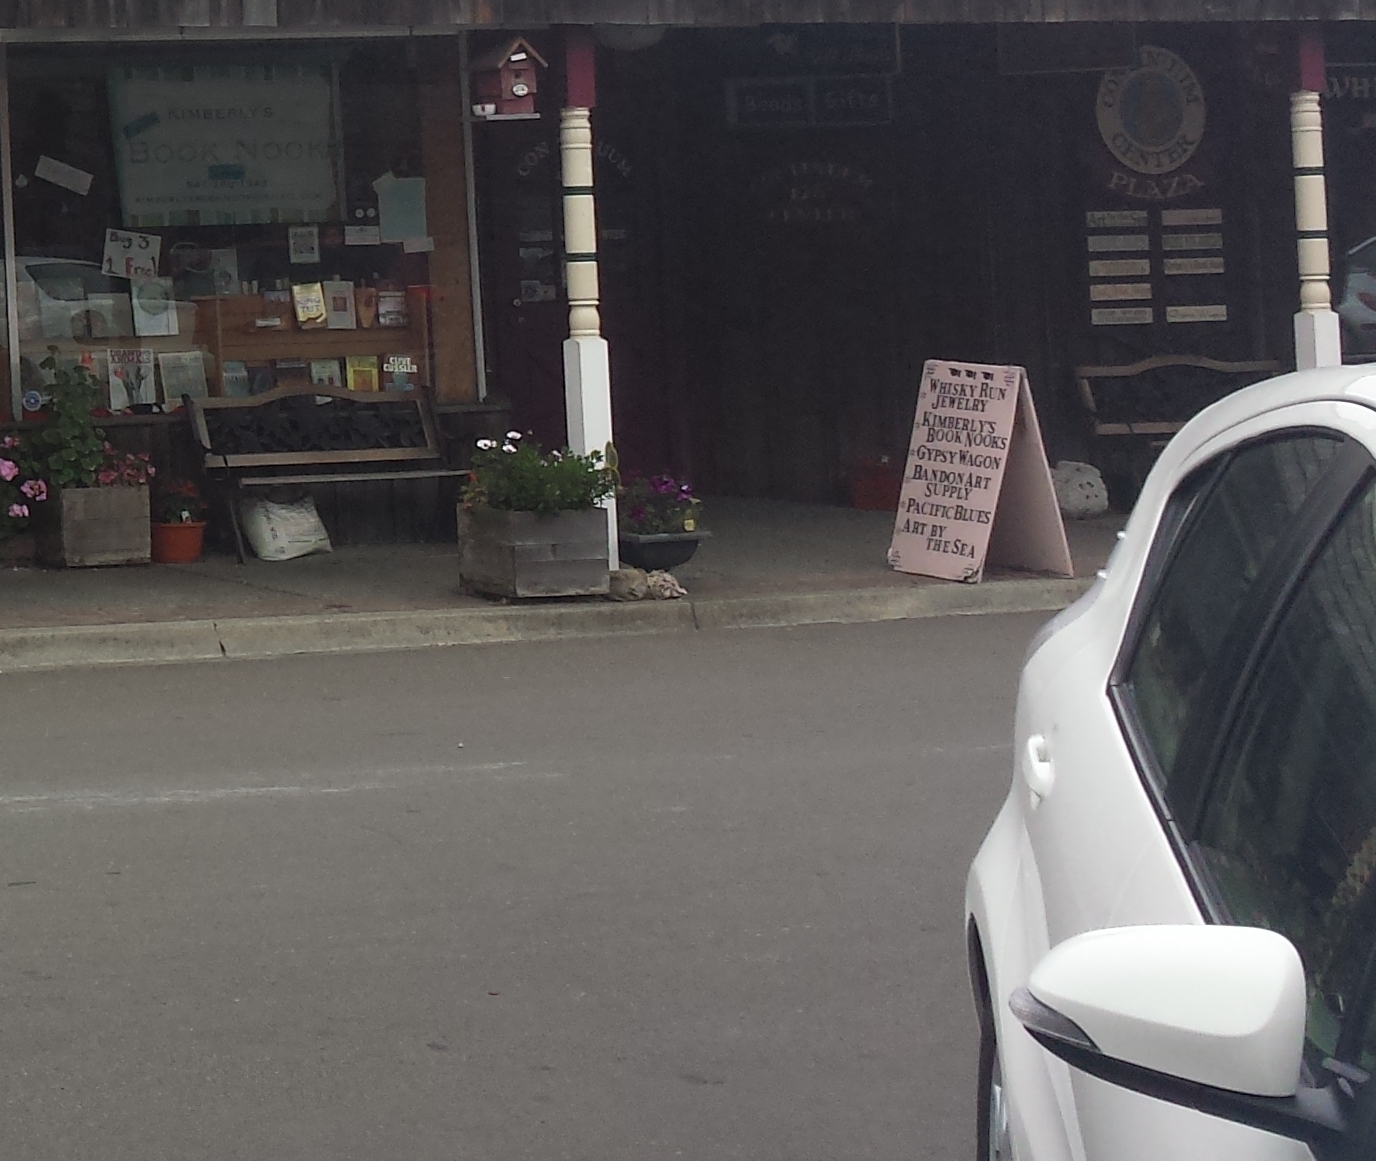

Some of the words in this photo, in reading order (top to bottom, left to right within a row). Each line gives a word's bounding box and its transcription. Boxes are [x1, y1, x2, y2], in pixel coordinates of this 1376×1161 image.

[129, 141, 217, 164] BOOK
[1112, 132, 1196, 167] CENTER
[1106, 170, 1205, 200] PLAZA
[138, 235, 150, 250] 3
[929, 378, 978, 398] WHISKY
[980, 382, 1008, 401] RUN
[931, 395, 988, 412] JEWELRY
[921, 411, 997, 434] KIMBERLY'S
[925, 427, 962, 444] BOOK
[964, 431, 1008, 450] NOOKS
[916, 445, 958, 464] GYPSY
[959, 450, 1002, 470] WAGON
[911, 464, 964, 485] BANDON
[965, 473, 992, 489] ART
[924, 482, 972, 500] SUPPLY
[905, 498, 954, 519] PACIFIC
[955, 505, 992, 524] BLUES
[901, 518, 928, 535] ART
[930, 524, 947, 538] BY
[926, 537, 950, 553] THE
[951, 539, 975, 559] SEA
